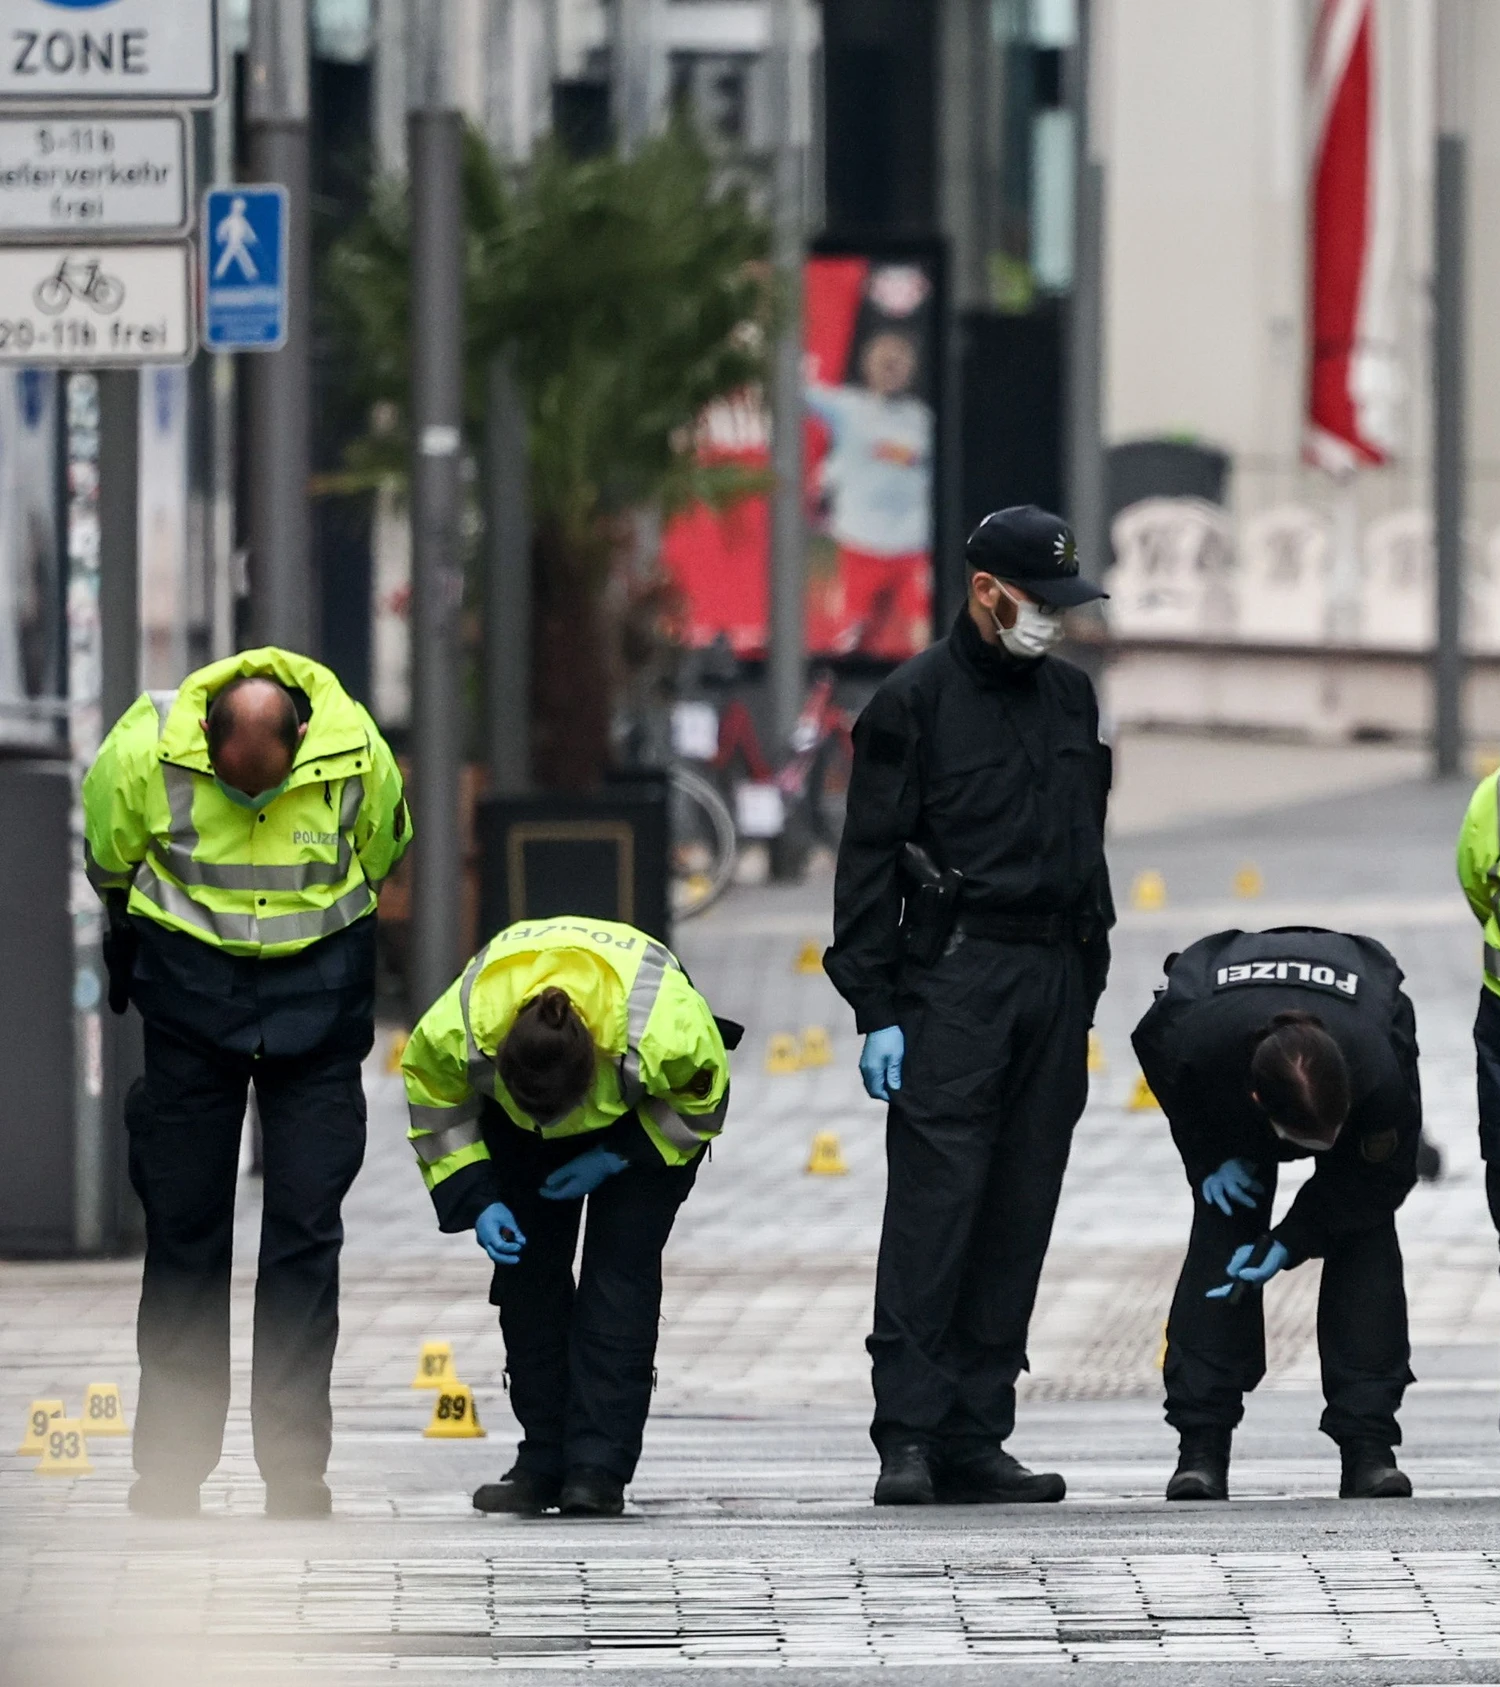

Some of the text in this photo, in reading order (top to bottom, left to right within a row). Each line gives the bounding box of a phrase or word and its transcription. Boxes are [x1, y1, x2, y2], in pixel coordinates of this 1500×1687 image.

[12, 28, 150, 76] ZONE
[1217, 961, 1358, 995] POLIZEI
[422, 1354, 448, 1377] 87
[90, 1394, 117, 1419] 88
[438, 1394, 466, 1421] 89
[49, 1431, 80, 1459] 93
